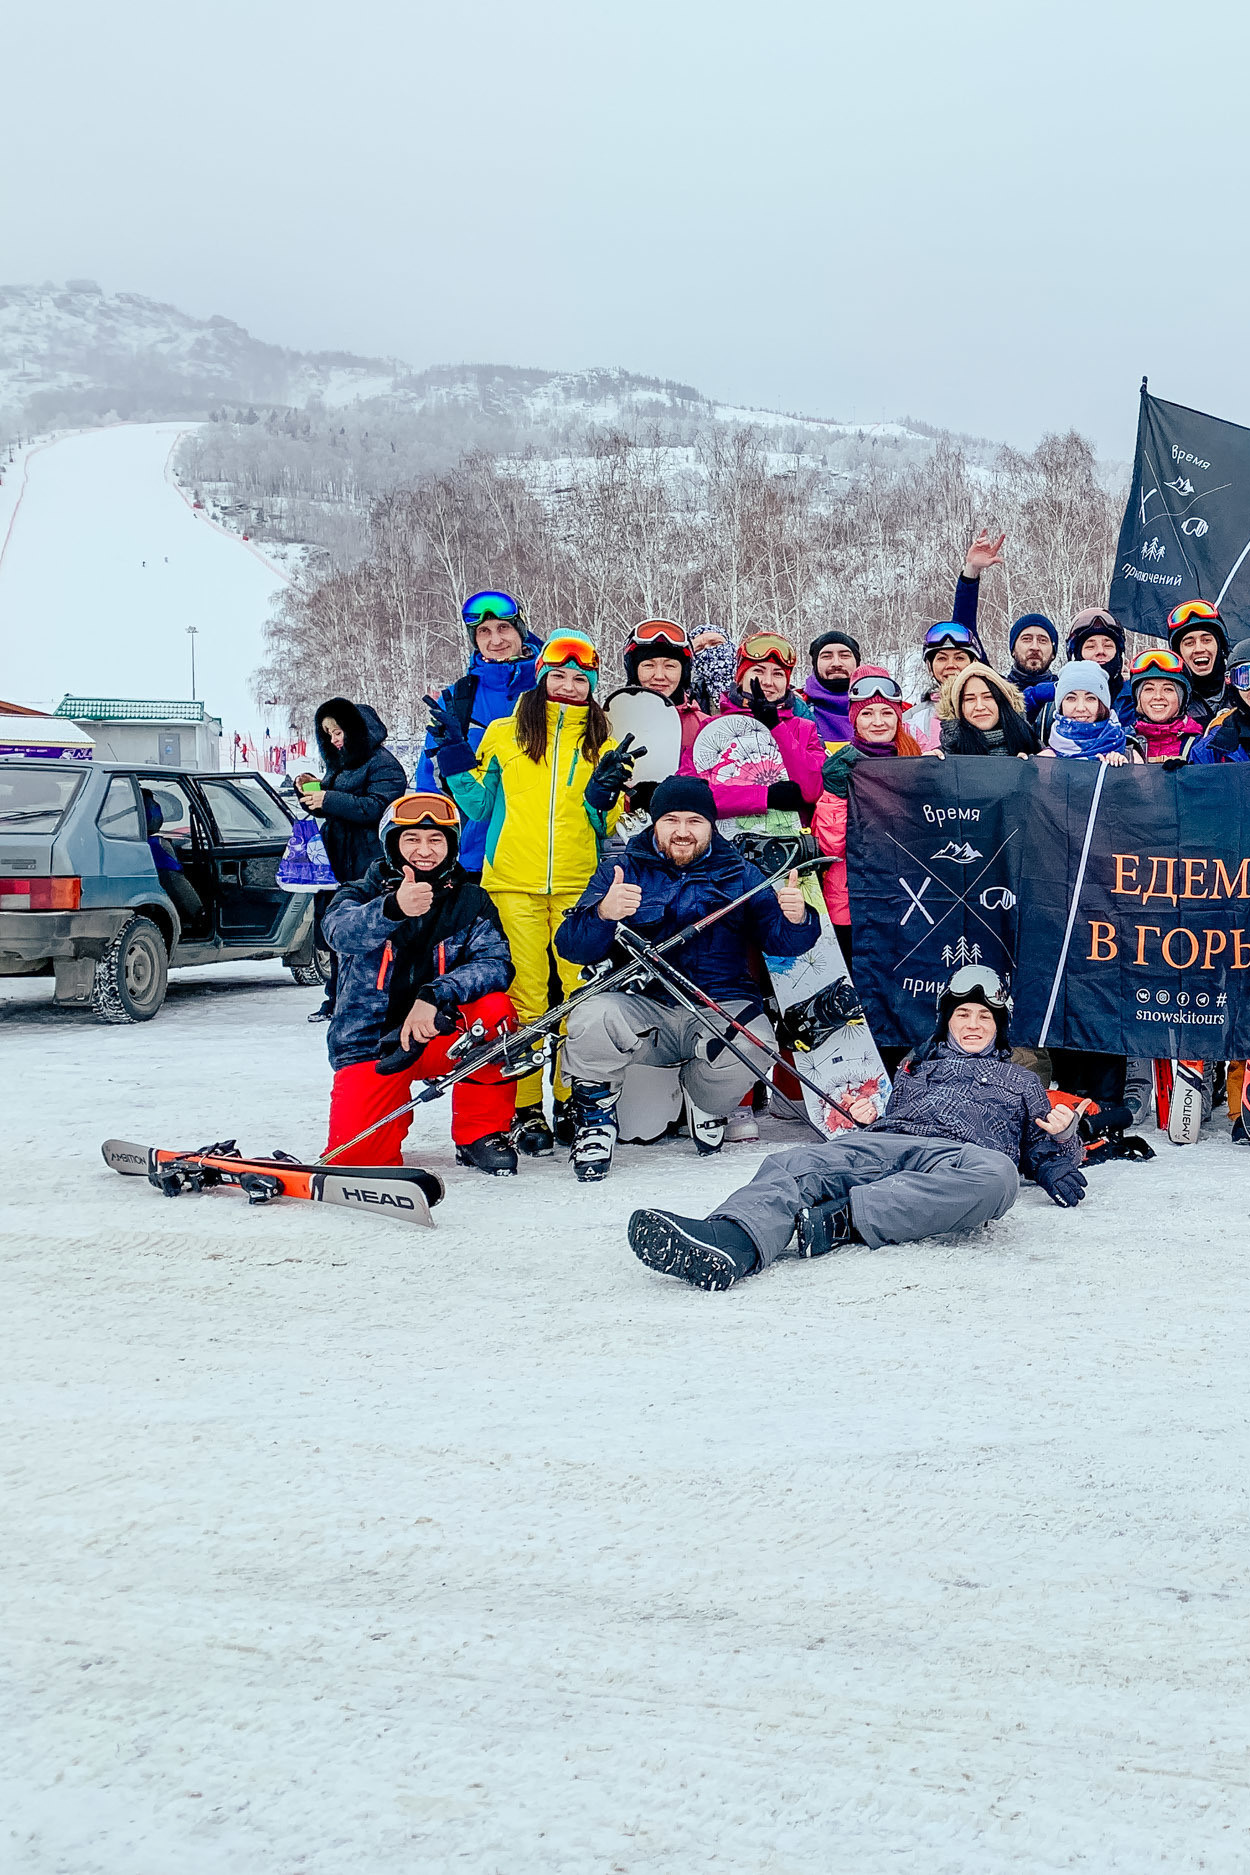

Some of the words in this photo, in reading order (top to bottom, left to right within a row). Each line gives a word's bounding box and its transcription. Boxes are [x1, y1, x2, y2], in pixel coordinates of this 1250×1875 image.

[1172, 444, 1211, 470] время
[922, 804, 981, 828] время
[1086, 920, 1119, 961] В
[1135, 1009, 1225, 1025] snowskitours
[1182, 1088, 1194, 1140] AMBITION
[110, 1152, 147, 1166] AMBITION
[341, 1187, 415, 1210] HEAD
